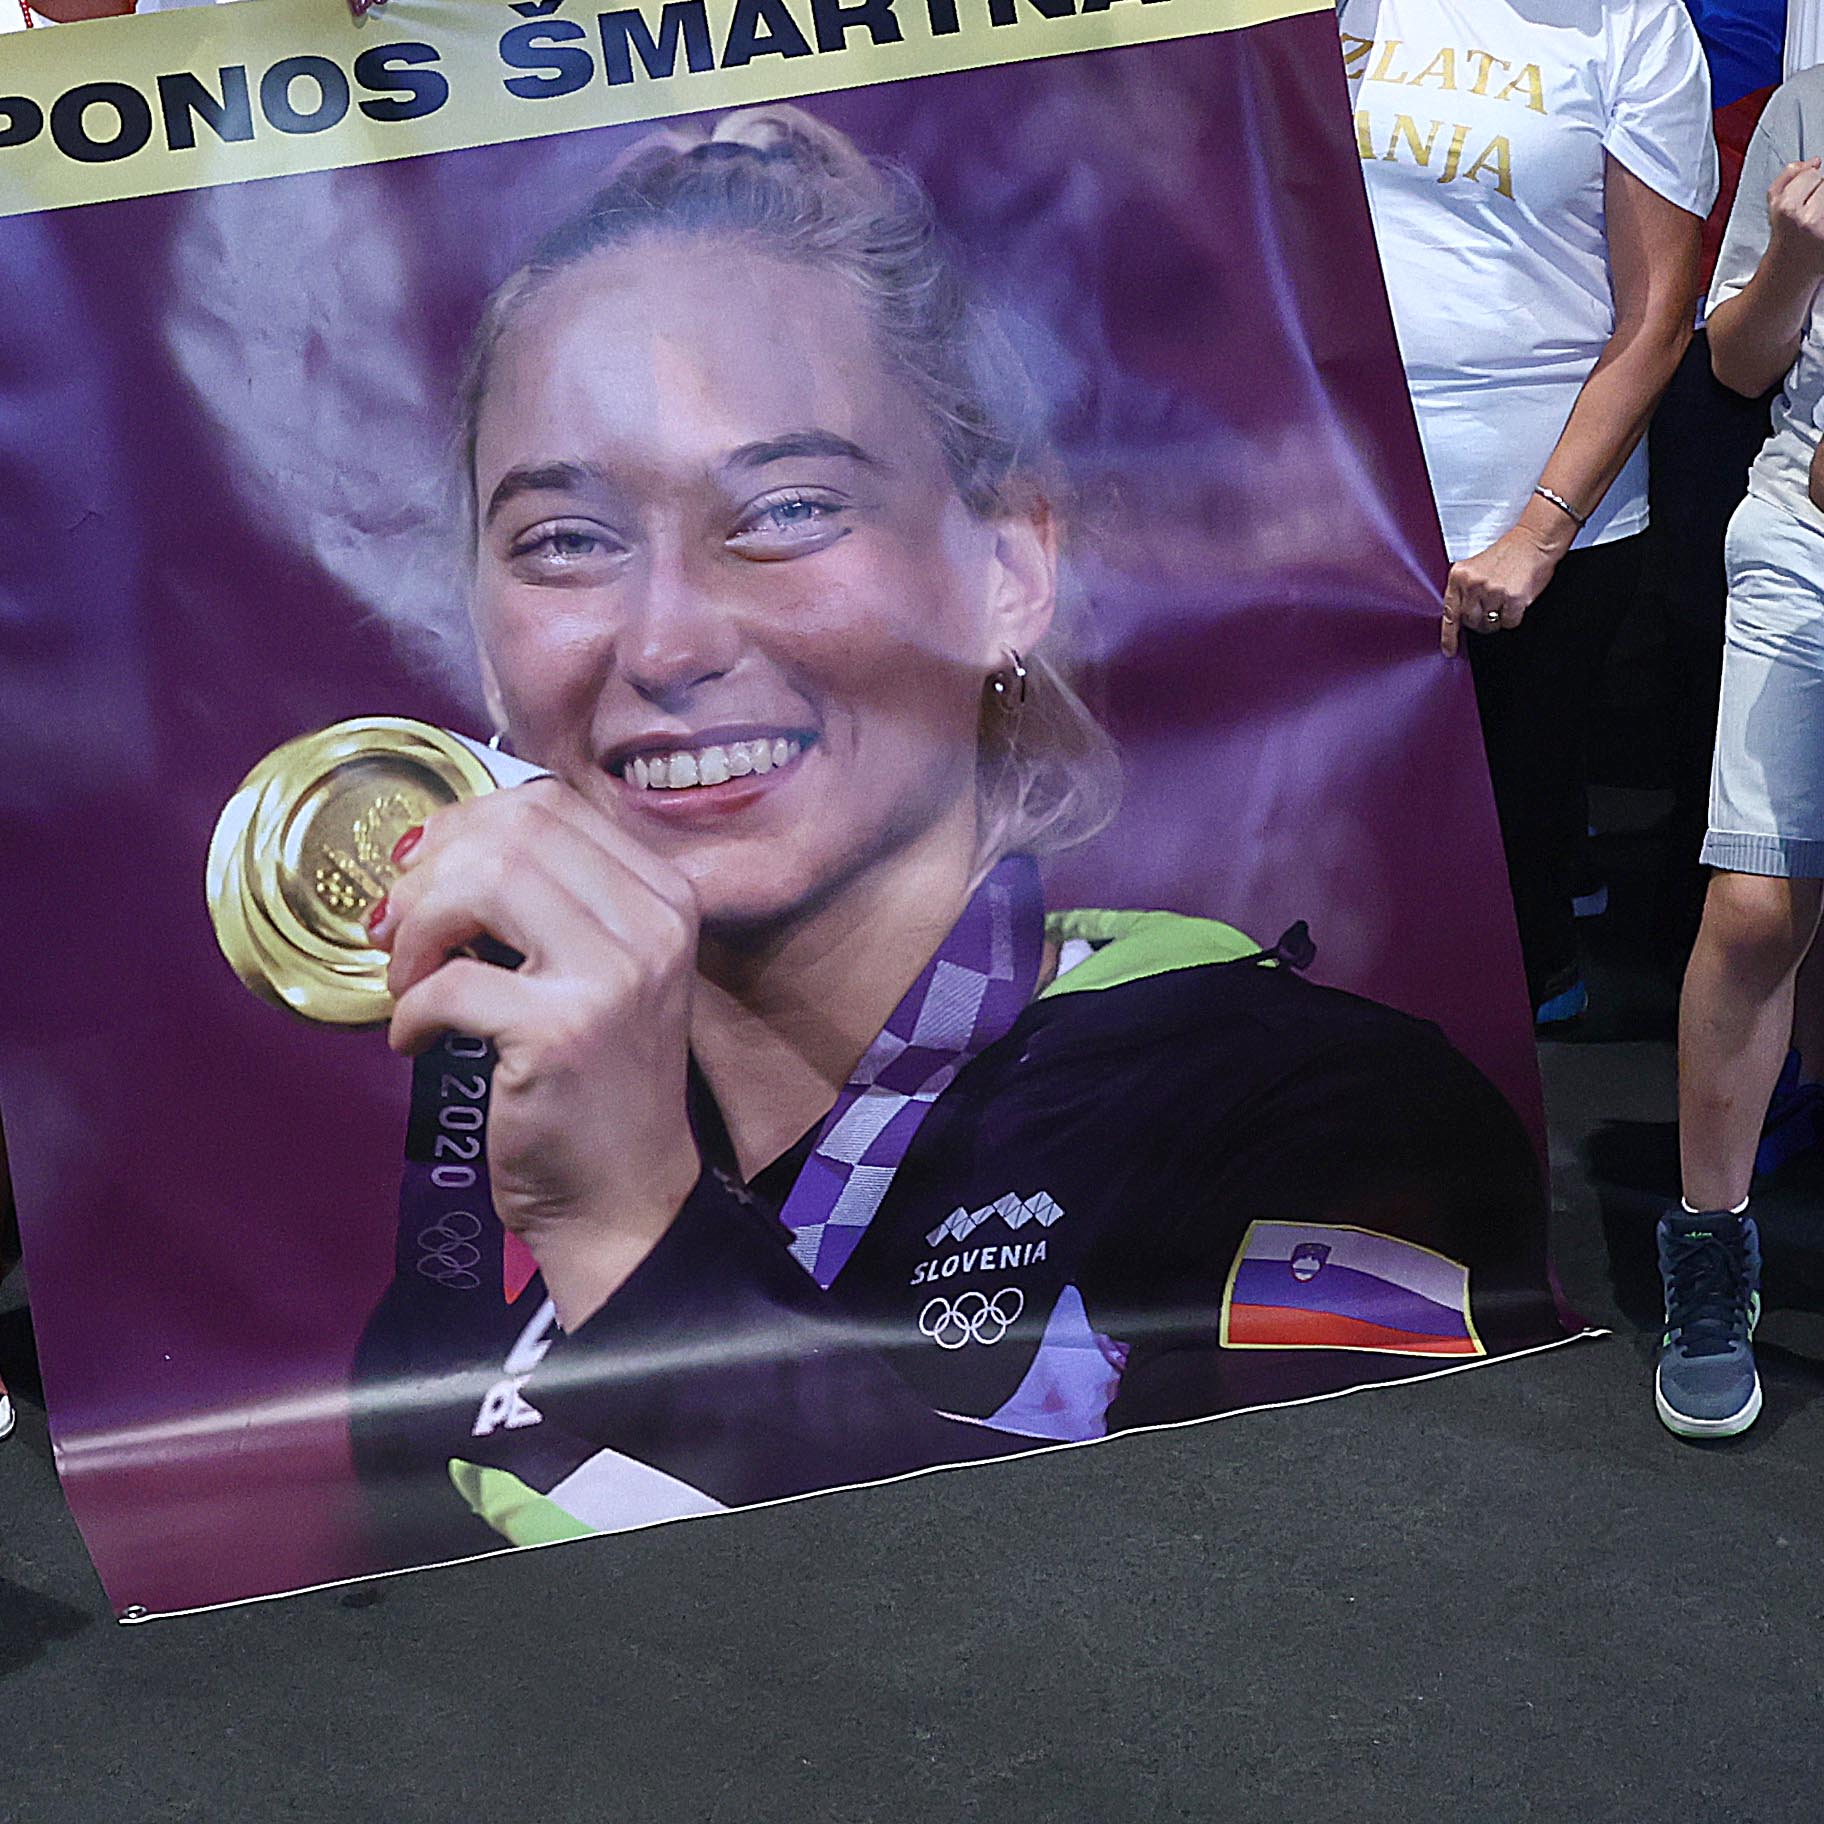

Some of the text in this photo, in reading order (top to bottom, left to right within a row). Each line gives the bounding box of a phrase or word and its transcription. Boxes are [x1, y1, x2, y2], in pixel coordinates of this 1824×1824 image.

[1340, 32, 1548, 116] ZLATA
[430, 1074, 488, 1189] 2020
[909, 1240, 1047, 1286] SLOVENIA
